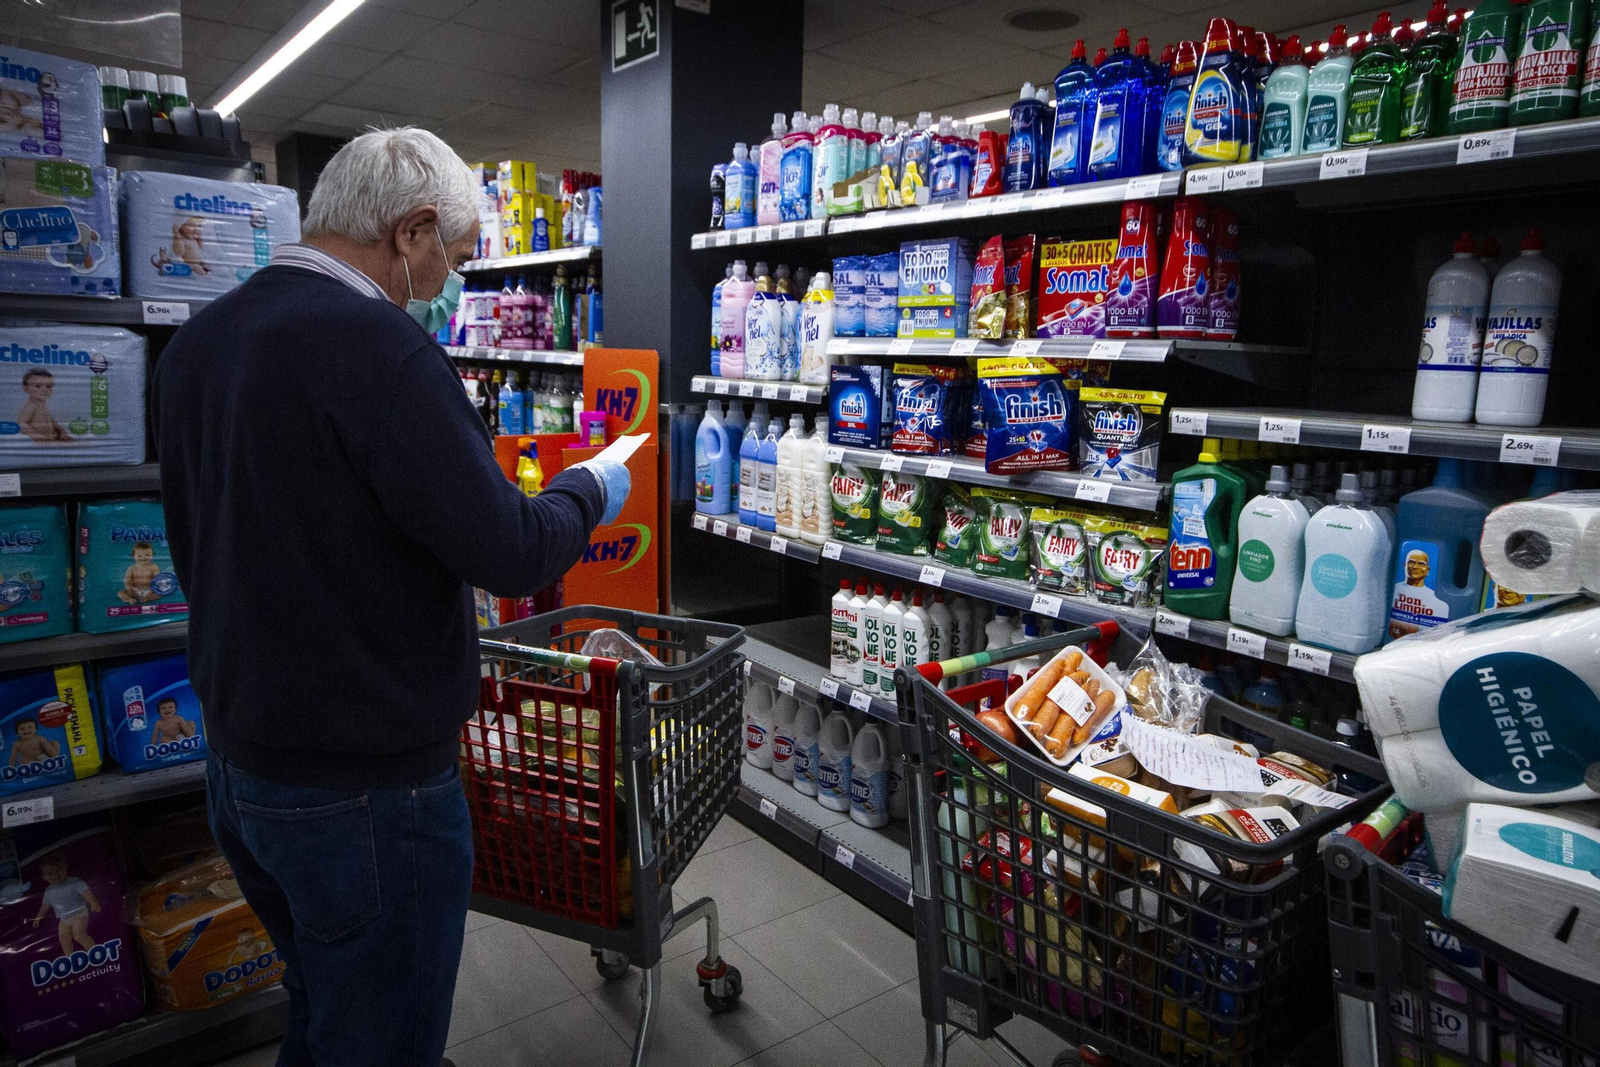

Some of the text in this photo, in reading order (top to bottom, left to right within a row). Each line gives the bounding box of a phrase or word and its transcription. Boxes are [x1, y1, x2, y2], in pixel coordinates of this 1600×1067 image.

[0, 56, 40, 82] ino
[1515, 76, 1567, 90] CONCENTRADO
[1194, 92, 1227, 110] finish
[1456, 88, 1504, 99] CONCENTRADO
[1351, 99, 1379, 108] MANZANA
[1164, 111, 1186, 127] finis
[1196, 117, 1221, 126] POWER
[1463, 138, 1492, 150] 0,89€
[1325, 156, 1348, 168] 0,90€
[72, 169, 89, 191] 3
[1189, 174, 1209, 183] 4,99€
[1227, 169, 1247, 179] 0,90€
[174, 192, 254, 217] chelino
[3, 211, 73, 229] Chelino
[1126, 220, 1140, 231] 60
[1196, 217, 1207, 228] 60
[1069, 240, 1114, 265] GRATIS
[1183, 239, 1209, 257] Som
[905, 251, 933, 267] TODO
[834, 272, 853, 286] SAL
[865, 274, 885, 287] SAL
[904, 265, 947, 283] EN UNO
[1045, 264, 1110, 295] Somat
[914, 310, 931, 318] TODO
[1107, 307, 1126, 316] TODO
[1127, 307, 1140, 316] EN
[1180, 306, 1201, 315] TODO
[1211, 309, 1231, 318] TODO
[1058, 321, 1077, 329] TODO
[1111, 316, 1118, 325] 8
[1186, 316, 1193, 325] 8
[0, 343, 91, 366] chelino
[98, 380, 107, 391] 6
[841, 399, 863, 414] finish
[1005, 393, 1063, 419] finish
[1094, 410, 1138, 431] finish
[1175, 413, 1192, 424] 1,25€
[1264, 421, 1284, 432] 1,25€
[1366, 427, 1390, 439] 1,15€
[1504, 438, 1535, 451] 2,69€
[832, 476, 865, 496] FAIRY
[881, 480, 916, 504] FAIRY
[945, 508, 971, 530] FAIR
[109, 523, 166, 543] PAÑA
[990, 515, 1023, 539] FAIRY
[1049, 535, 1080, 556] FAIRY
[1104, 547, 1142, 570] FAIRY
[1170, 538, 1212, 571] tenn
[1393, 598, 1434, 617] Limpio
[1398, 593, 1422, 607] Don
[109, 607, 120, 615] 25
[1158, 614, 1176, 625] 2,09€
[1231, 632, 1250, 645] 1,19€
[1293, 647, 1314, 662] 1,19€
[1475, 666, 1538, 785] HIGIÉNICO
[1512, 686, 1555, 759] PAPEL
[748, 732, 769, 745] TREX
[143, 734, 202, 761] DODOT
[2, 754, 67, 781] DODOT
[794, 755, 813, 771] TREX
[819, 770, 843, 784] UTREX
[850, 782, 875, 799] UTREX
[7, 806, 33, 817] 6,99€
[1248, 817, 1272, 843] HARIN
[30, 938, 122, 987] DODOT
[78, 962, 121, 982] activity
